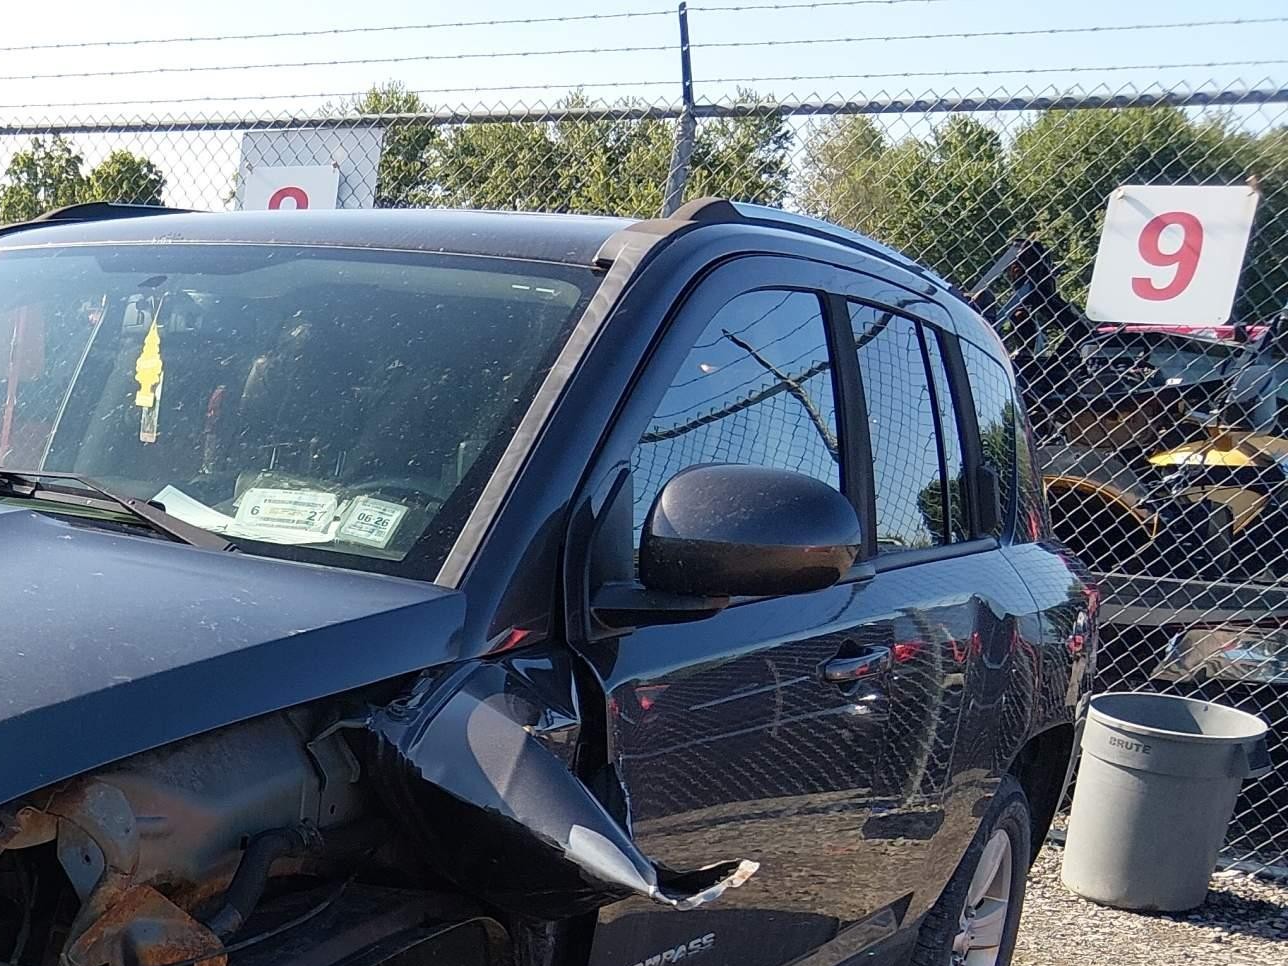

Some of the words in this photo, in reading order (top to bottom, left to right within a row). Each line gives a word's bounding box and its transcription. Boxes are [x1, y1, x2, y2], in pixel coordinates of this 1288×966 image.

[1130, 209, 1205, 303] 9
[307, 511, 327, 522] 27
[1108, 735, 1152, 755] BRUTE
